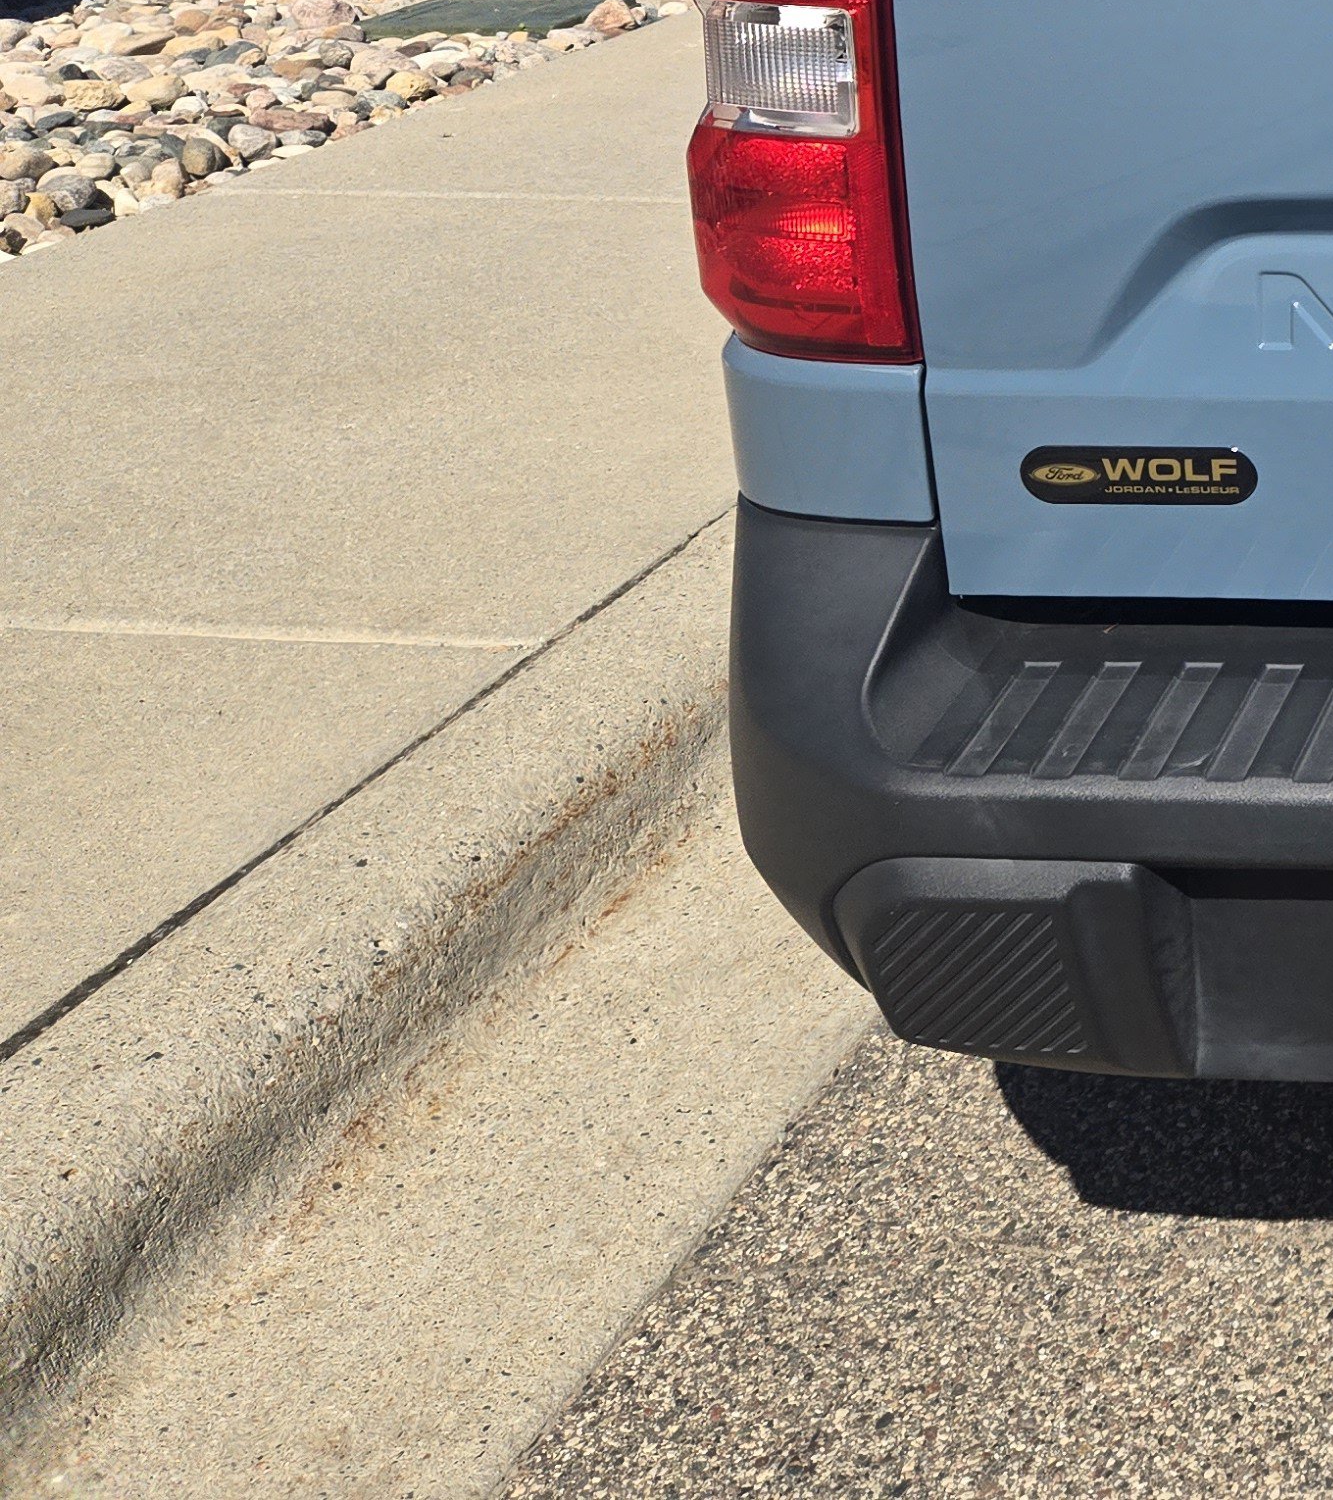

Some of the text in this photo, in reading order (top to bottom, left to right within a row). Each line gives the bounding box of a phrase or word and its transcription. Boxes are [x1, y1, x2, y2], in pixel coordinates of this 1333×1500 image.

[1045, 458, 1238, 482] Ford WOLF
[1104, 485, 1166, 494] JORDAN
